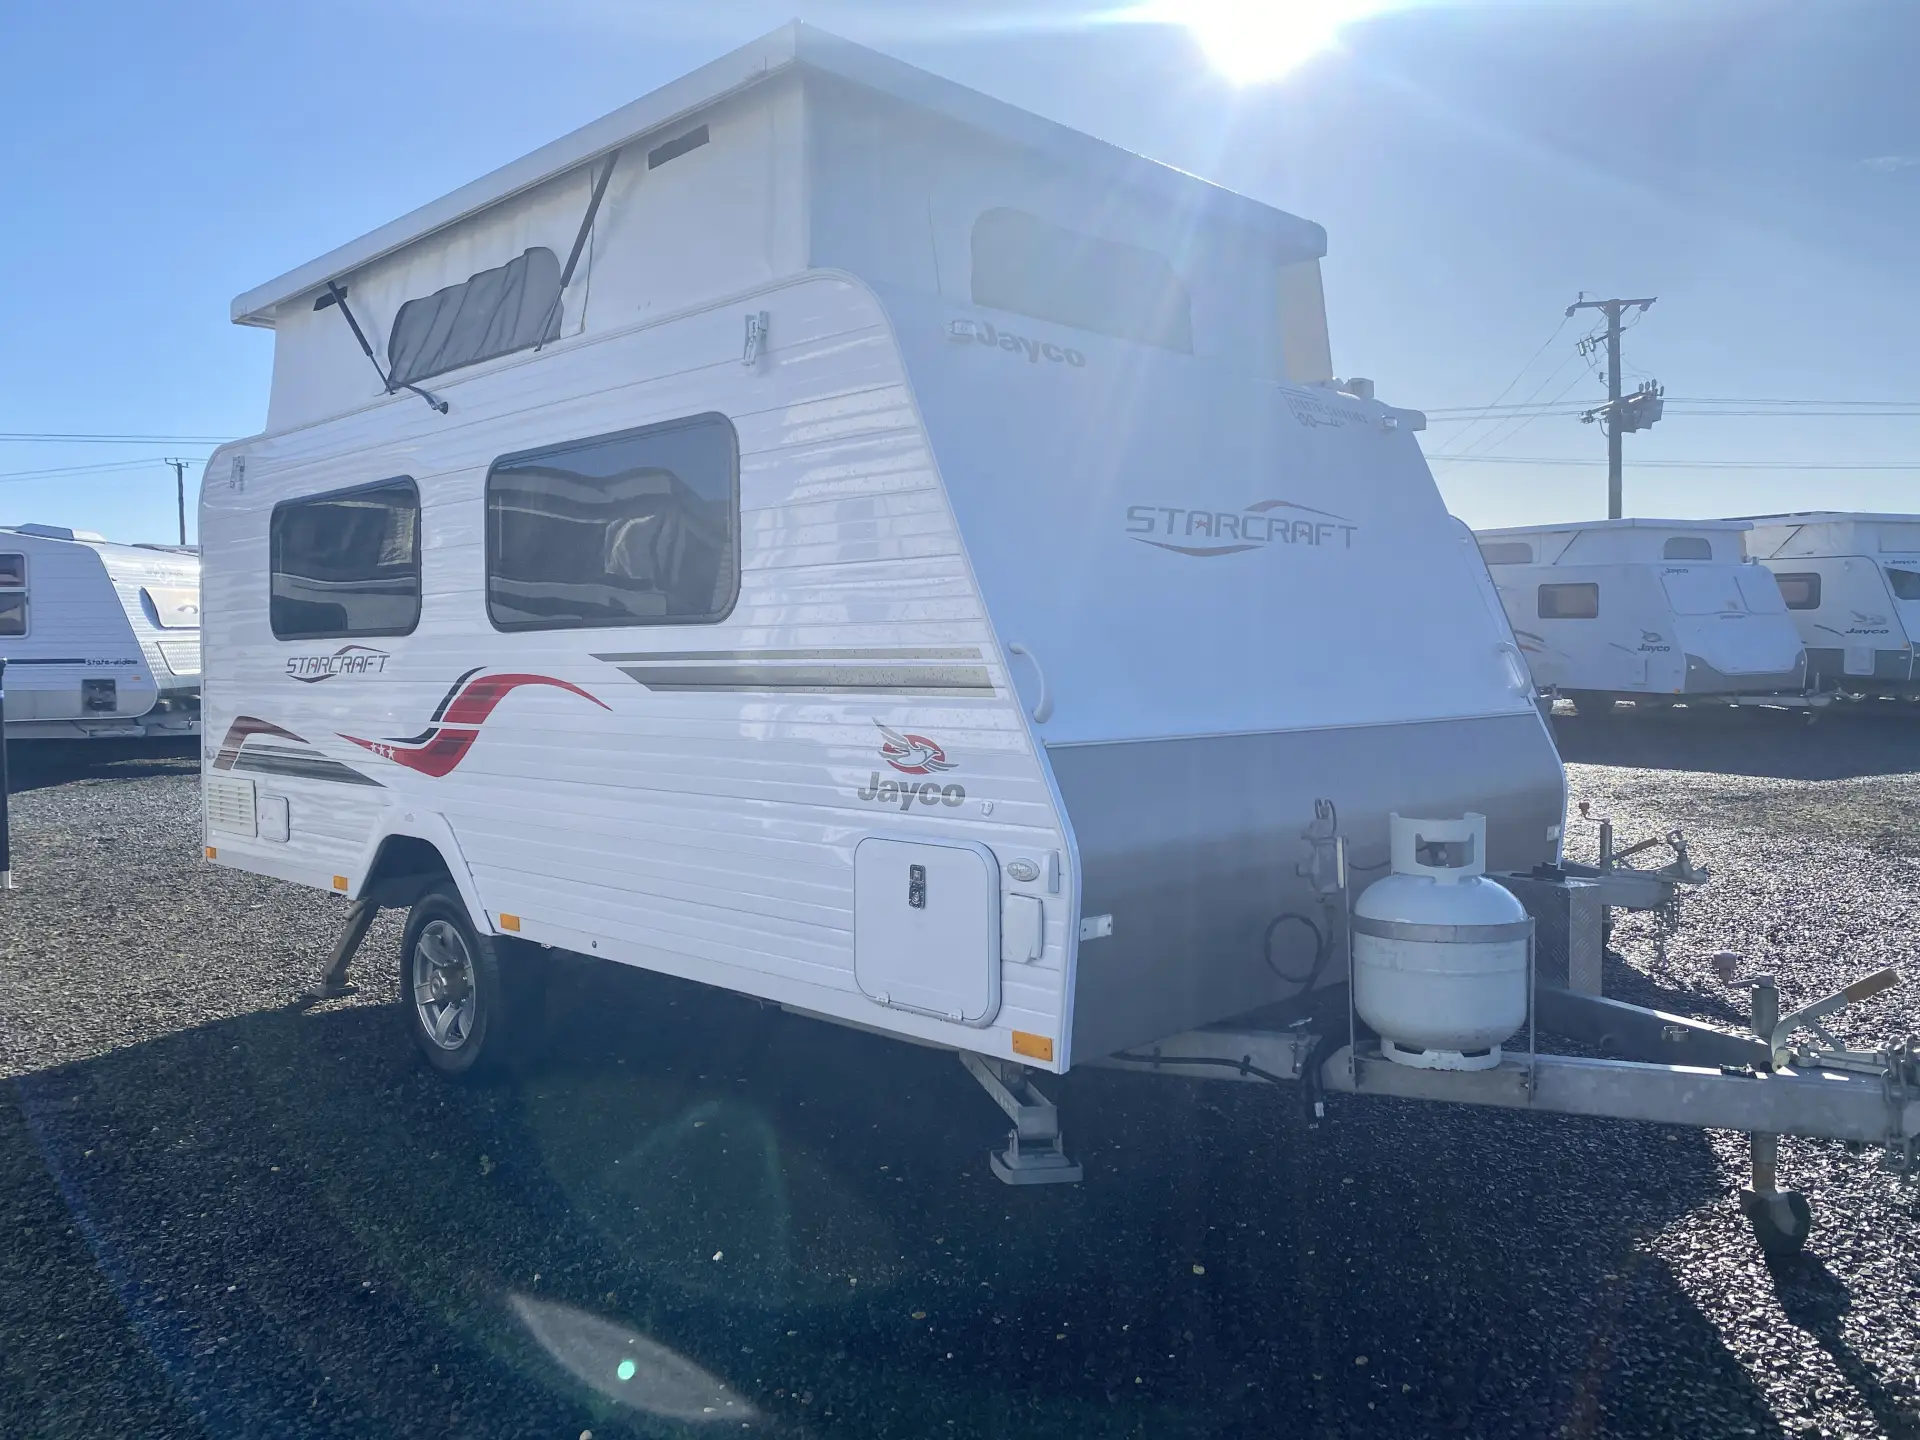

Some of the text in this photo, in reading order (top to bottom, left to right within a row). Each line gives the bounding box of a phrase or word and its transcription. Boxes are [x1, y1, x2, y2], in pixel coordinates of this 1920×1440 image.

[976, 321, 1086, 367] Jayco
[1126, 505, 1358, 549] STARCRAFT
[285, 654, 391, 674] STARCRAFT
[1637, 643, 1671, 654] Jayco
[857, 771, 966, 811] Jayco
